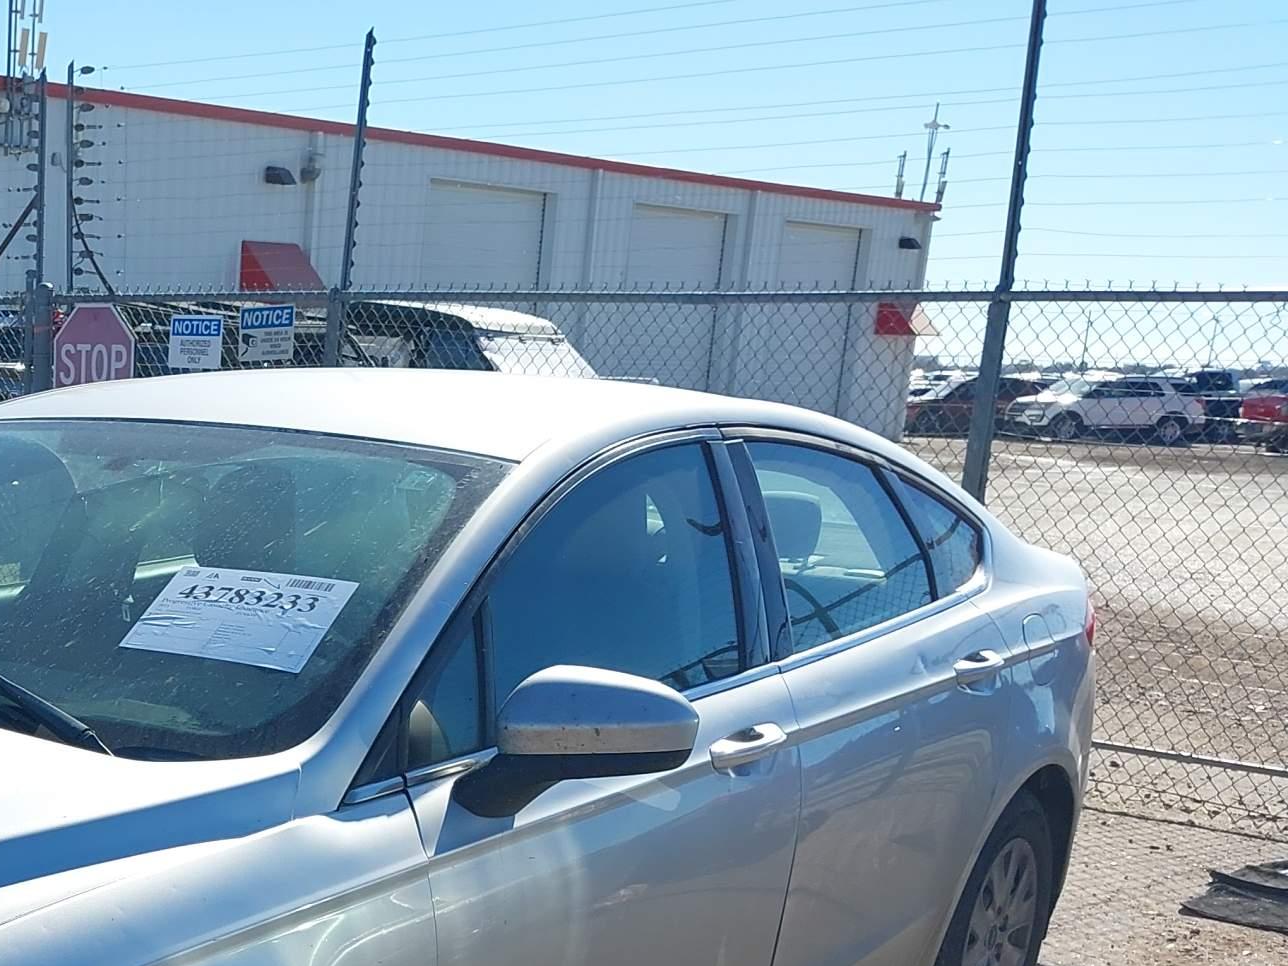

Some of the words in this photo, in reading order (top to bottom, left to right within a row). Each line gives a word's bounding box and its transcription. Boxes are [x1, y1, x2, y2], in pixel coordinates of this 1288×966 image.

[174, 320, 219, 335] NOTICE
[242, 309, 292, 327] NOTICE
[59, 343, 128, 385] STOP
[176, 584, 320, 613] 43783233
